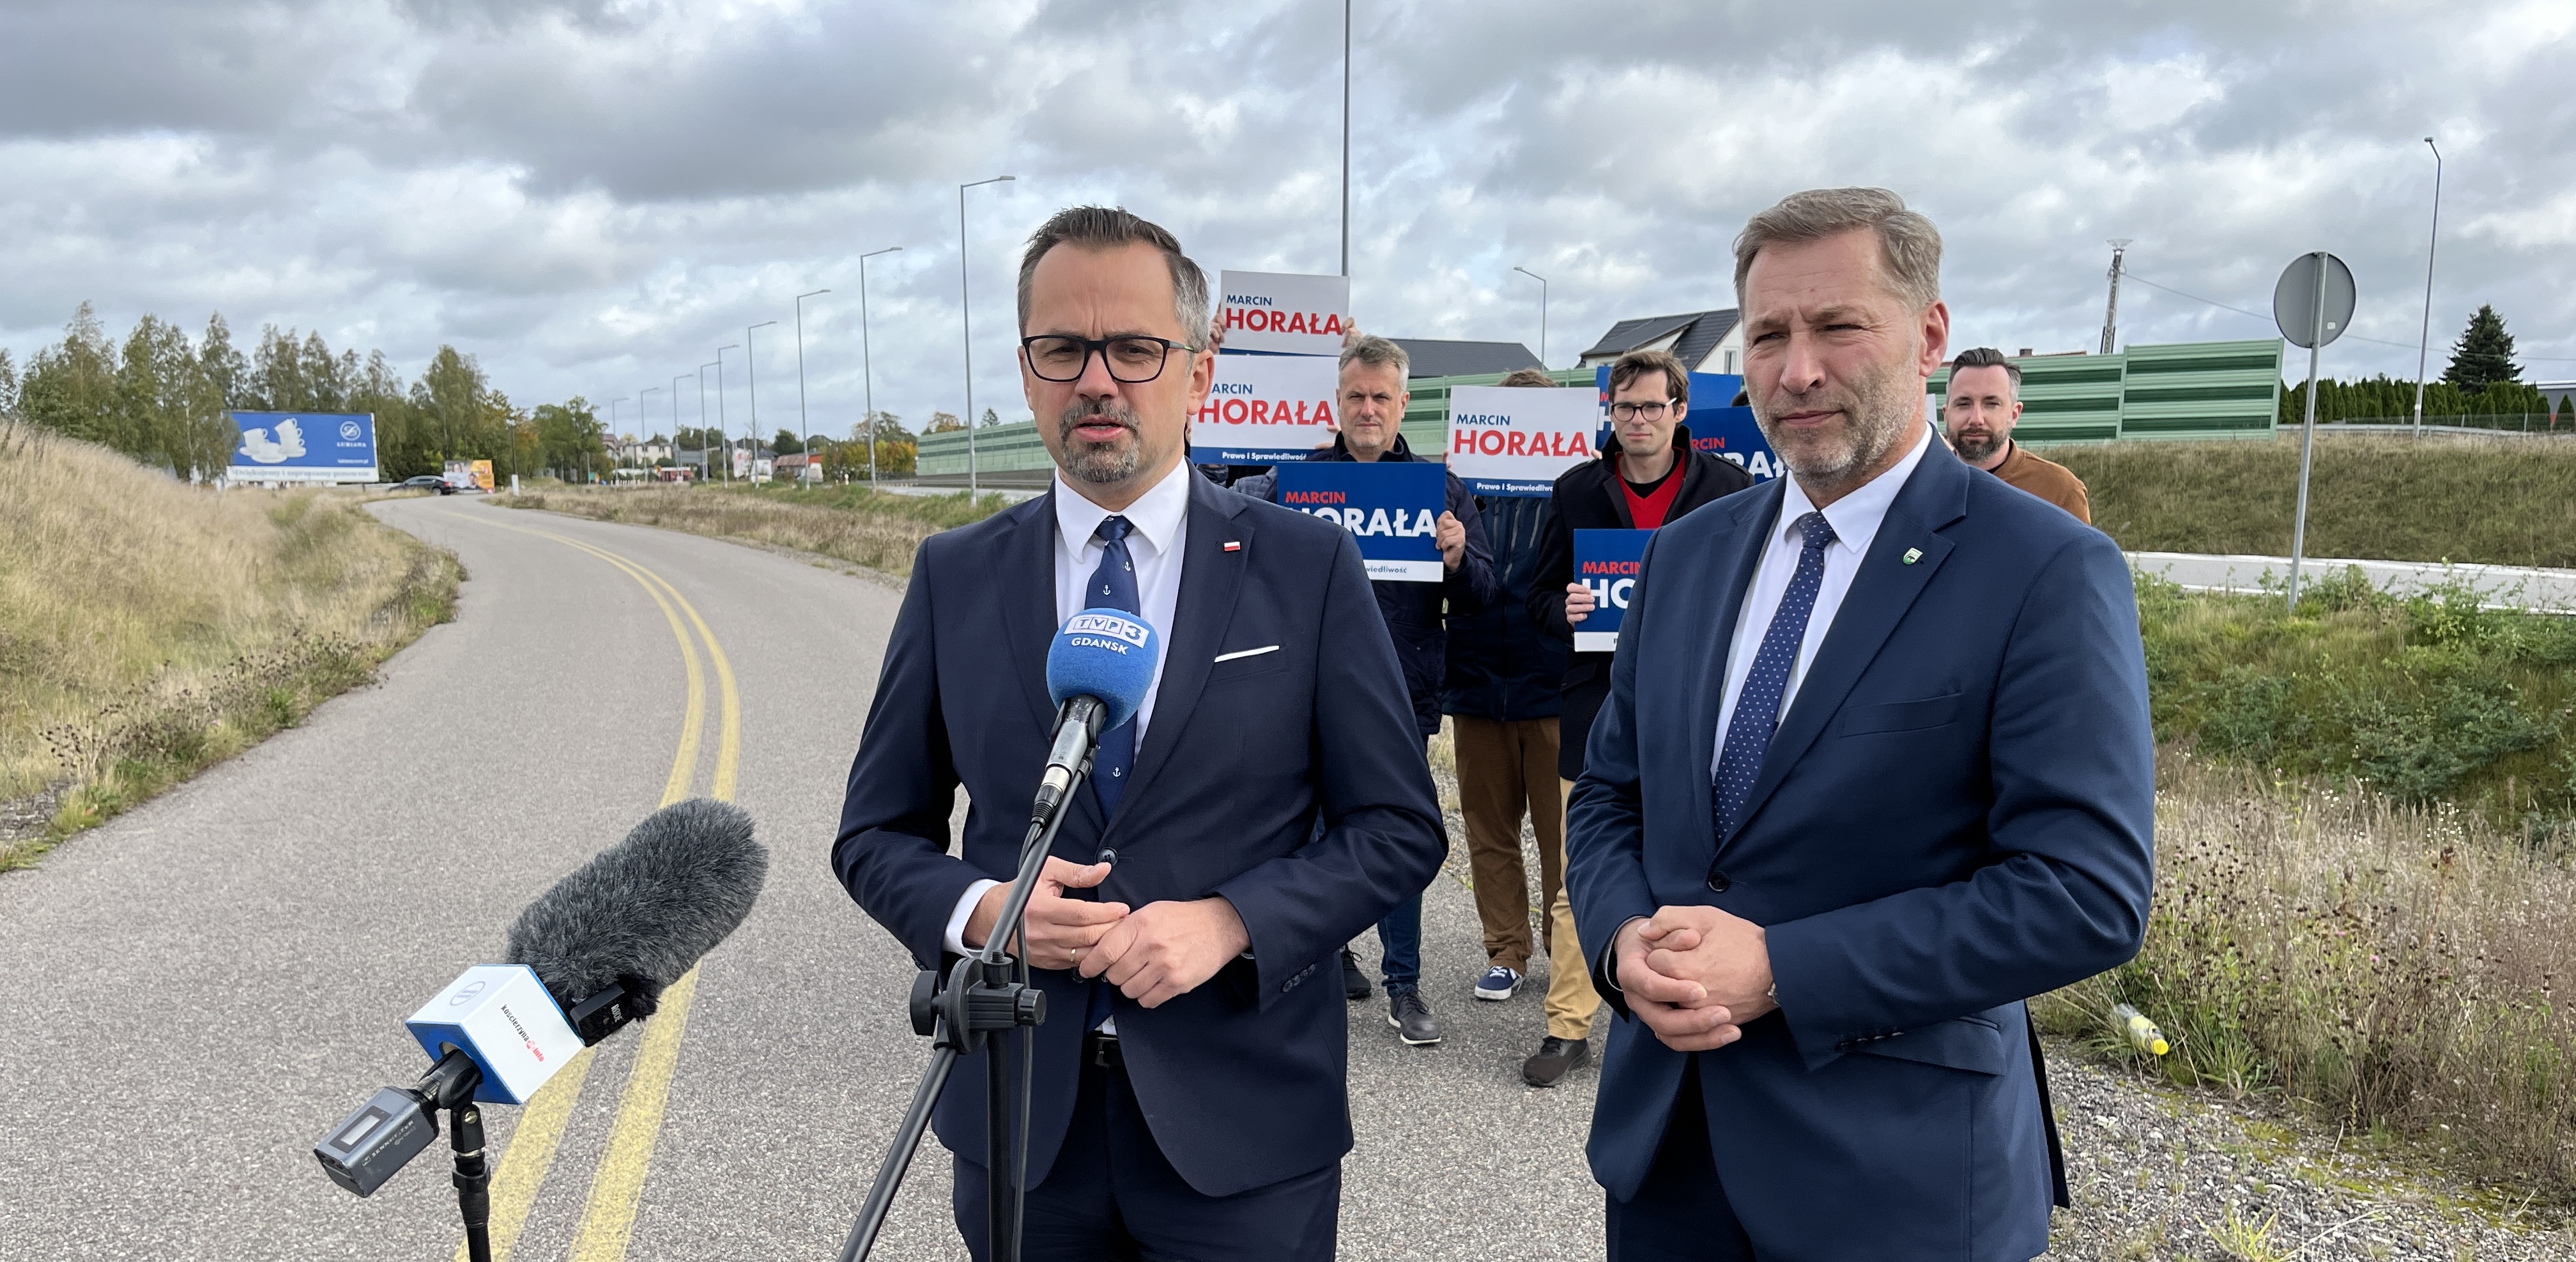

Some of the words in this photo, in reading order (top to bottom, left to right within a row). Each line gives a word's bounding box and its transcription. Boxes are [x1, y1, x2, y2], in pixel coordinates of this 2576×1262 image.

[1226, 295, 1272, 306] MARCIN
[1226, 307, 1342, 335] HORAŁA
[1211, 383, 1253, 394] ARCIN
[1198, 398, 1335, 426] HORAŁA
[1456, 413, 1510, 426] MARCIN
[1453, 429, 1589, 457] HORAŁA
[1690, 436, 1725, 450] RCIN
[1222, 451, 1245, 459] Prawo
[1506, 483, 1552, 492] Sprawiedliwo
[1285, 491, 1346, 504] MARCIN
[1366, 565, 1407, 574] wiedliwość
[1071, 637, 1129, 655] GDANSK
